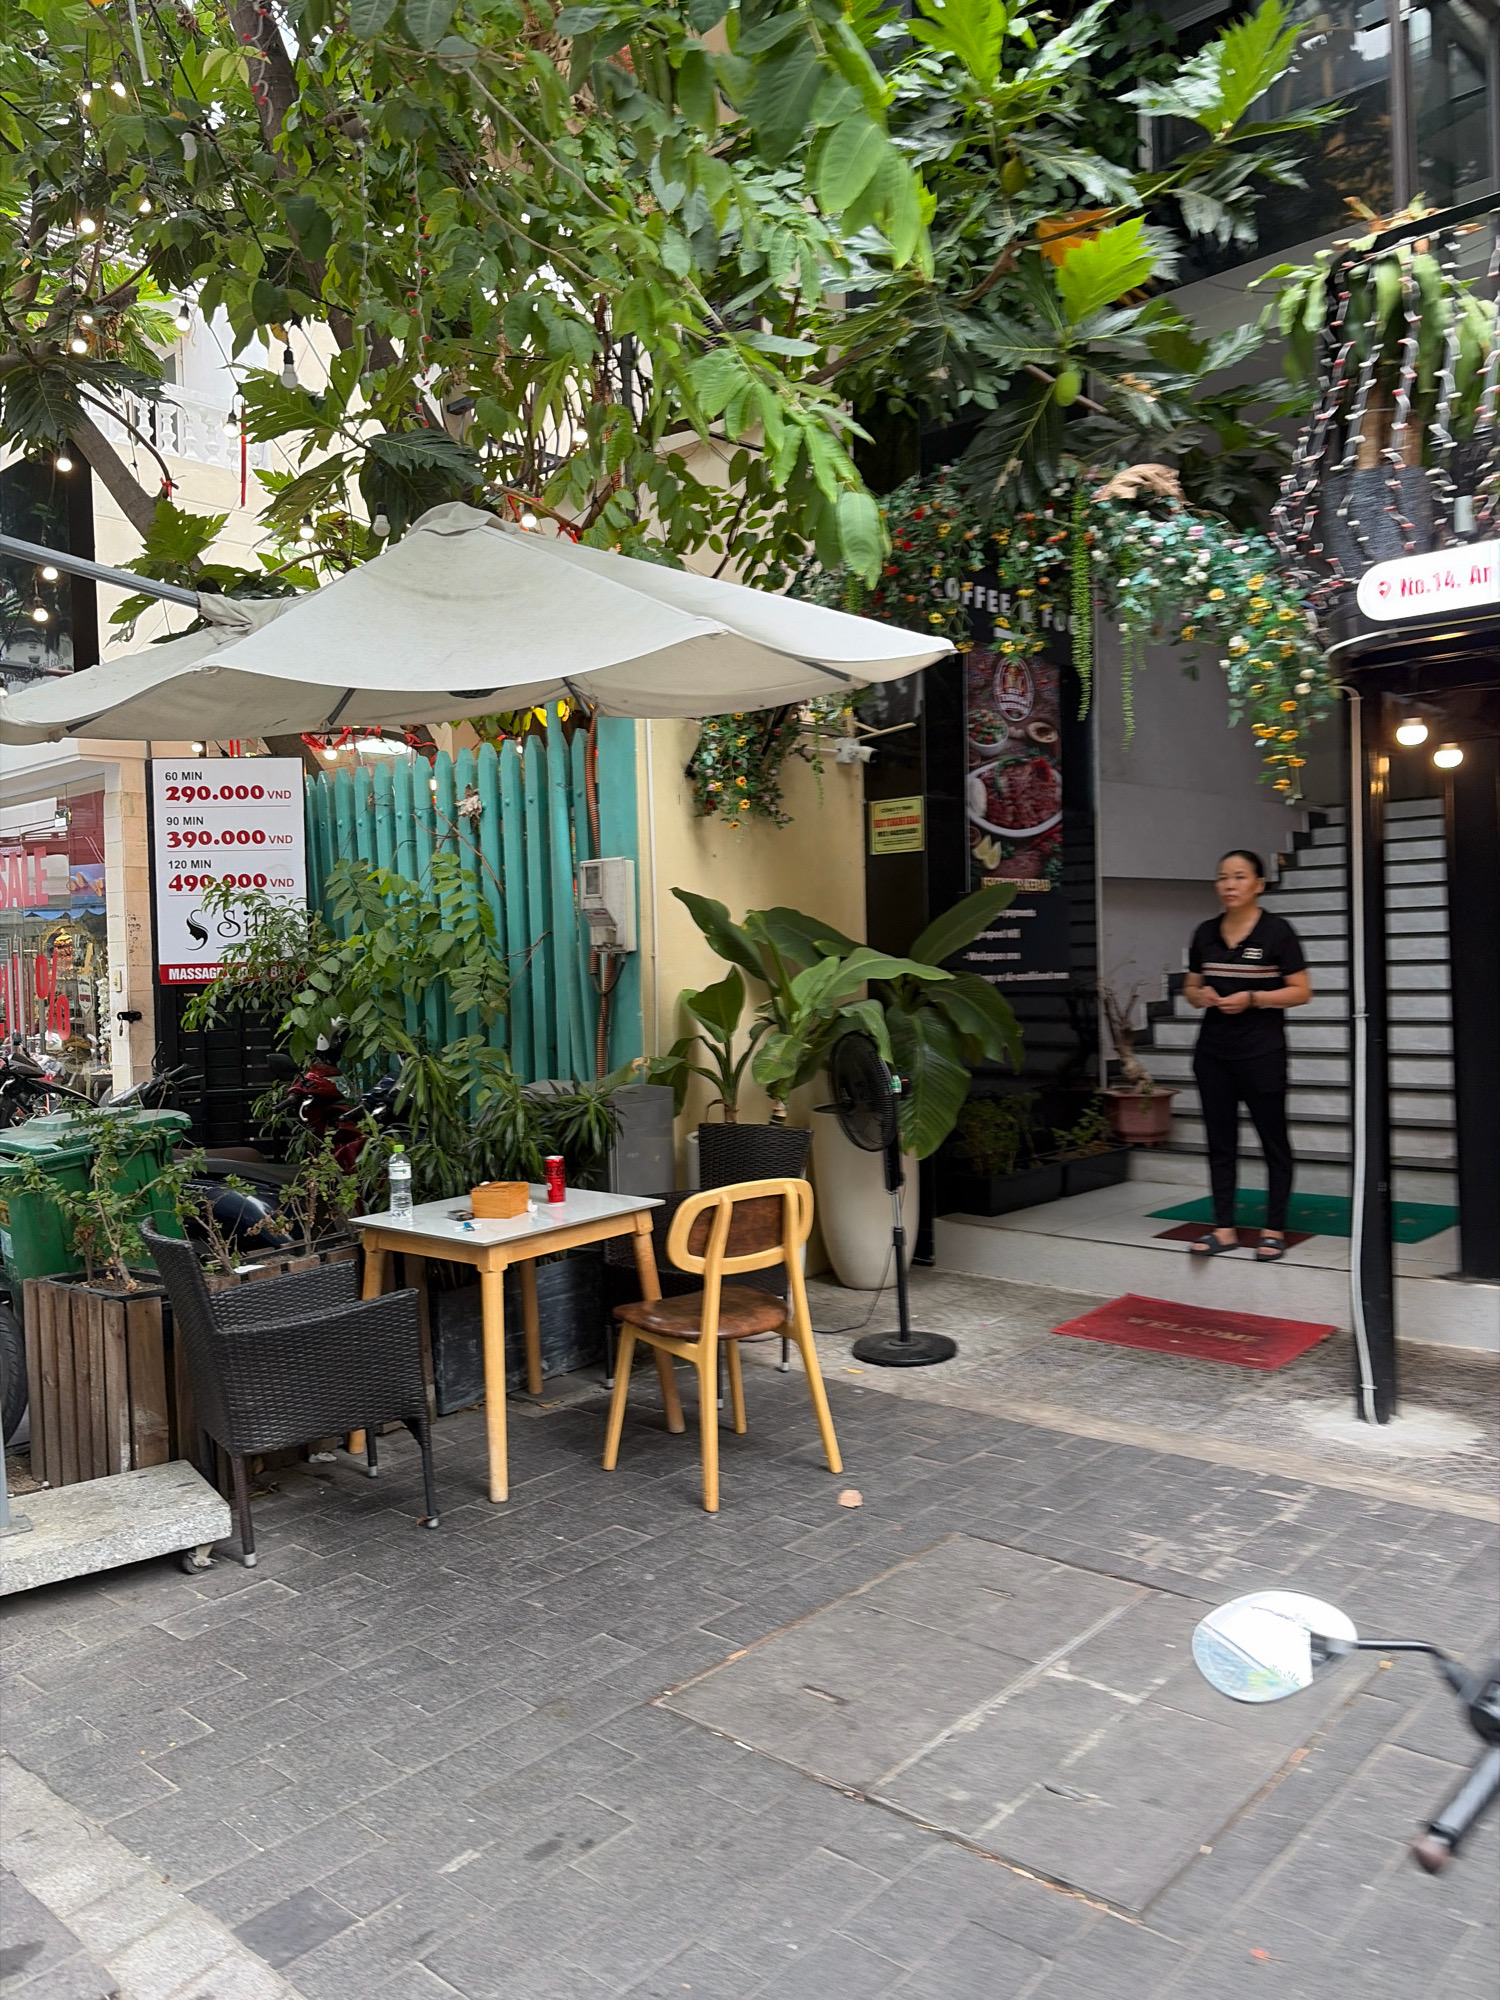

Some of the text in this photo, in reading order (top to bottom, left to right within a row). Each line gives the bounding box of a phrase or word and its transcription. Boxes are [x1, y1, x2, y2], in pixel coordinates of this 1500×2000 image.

[930, 577, 1011, 616] OFFEE
[165, 771, 203, 781] 60 MIN
[165, 785, 292, 803] 290.000 VND
[166, 816, 204, 826] 90 MIN
[167, 830, 293, 848] 390.000 VND
[168, 859, 212, 869] 120 MIN
[168, 873, 295, 892] 490.000 VND
[1127, 1316, 1264, 1342] WELCOME
